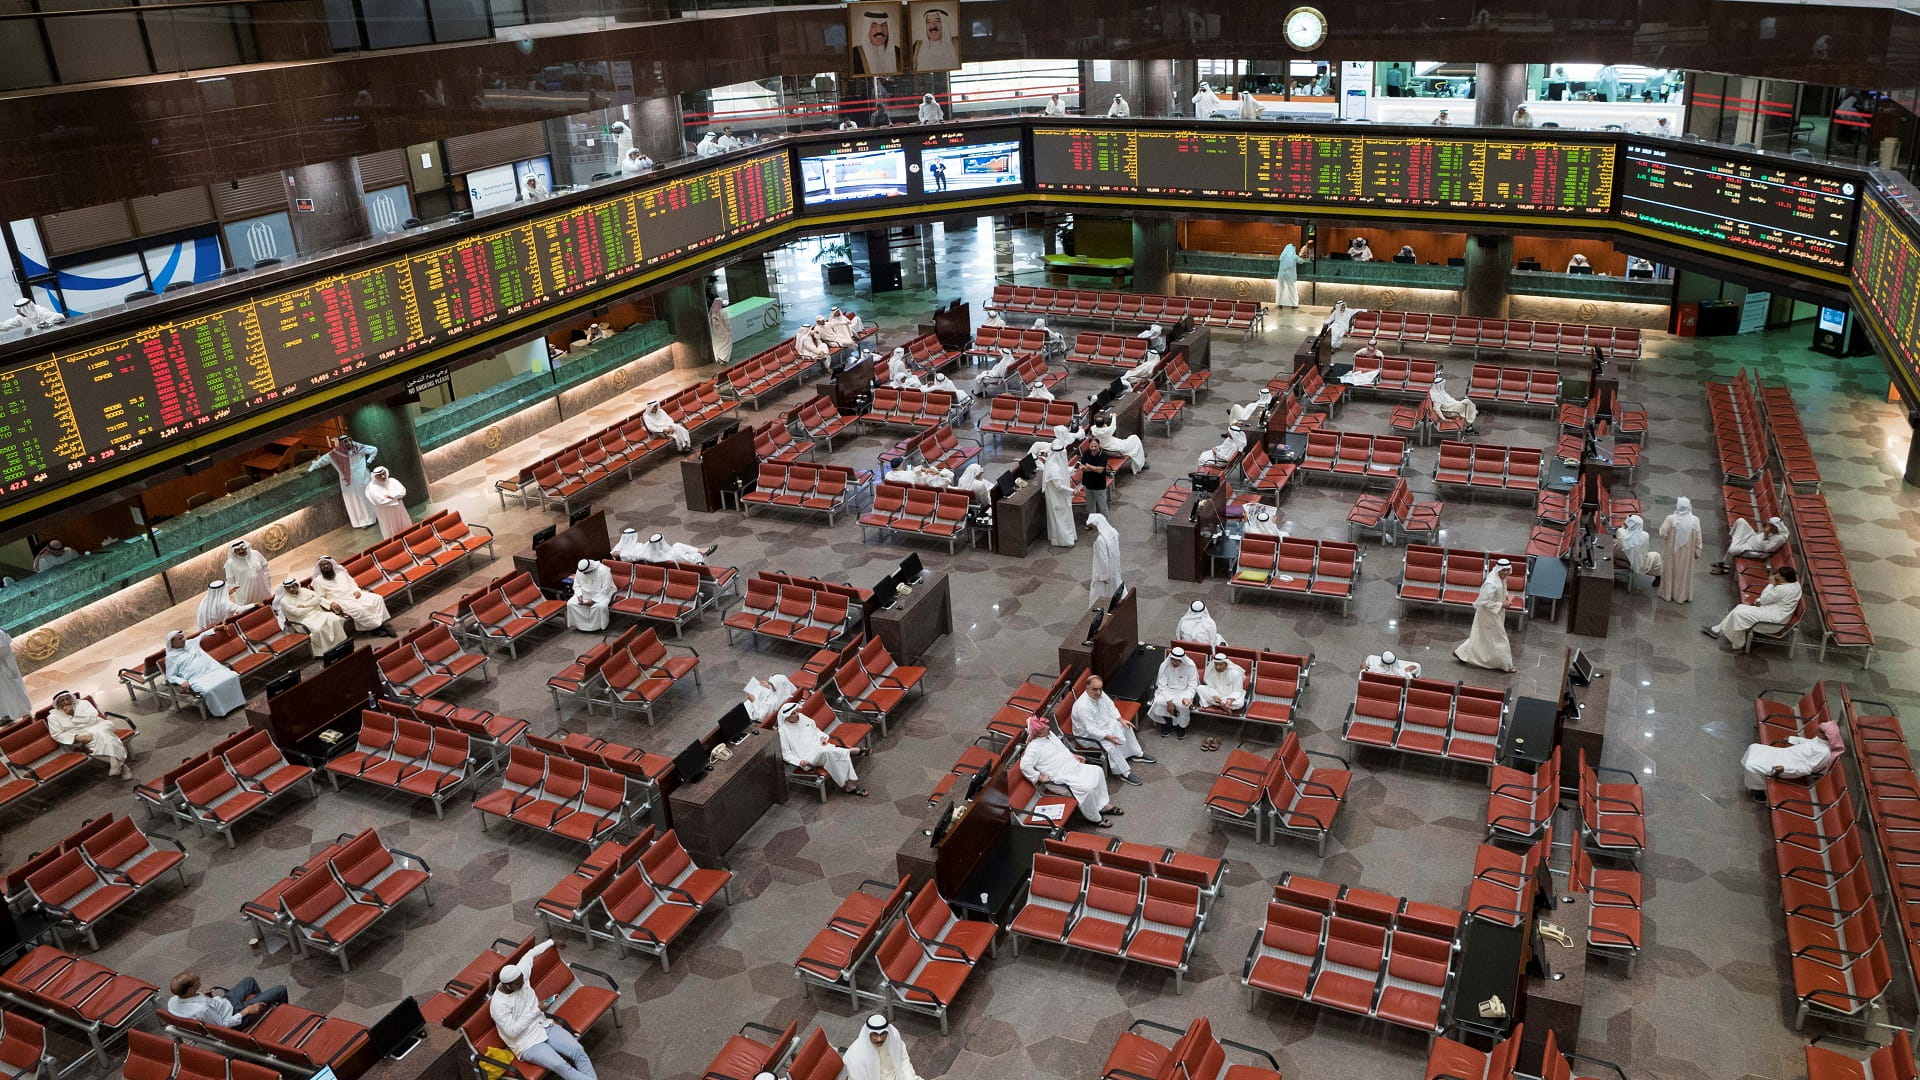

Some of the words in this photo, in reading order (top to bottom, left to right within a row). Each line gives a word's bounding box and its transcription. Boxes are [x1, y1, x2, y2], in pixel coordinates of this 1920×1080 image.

[200, 347, 215, 356] 10000
[201, 353, 217, 362] 10000
[203, 360, 219, 368] 10000
[209, 382, 225, 391] 10000
[406, 375, 426, 388] التدخين
[408, 386, 416, 395] NO
[416, 381, 435, 392] SMOKING
[434, 374, 450, 385] PLEASE
[159, 426, 180, 439] 2,241
[197, 415, 211, 425] 705
[67, 460, 83, 471] 535
[100, 449, 116, 460] 230
